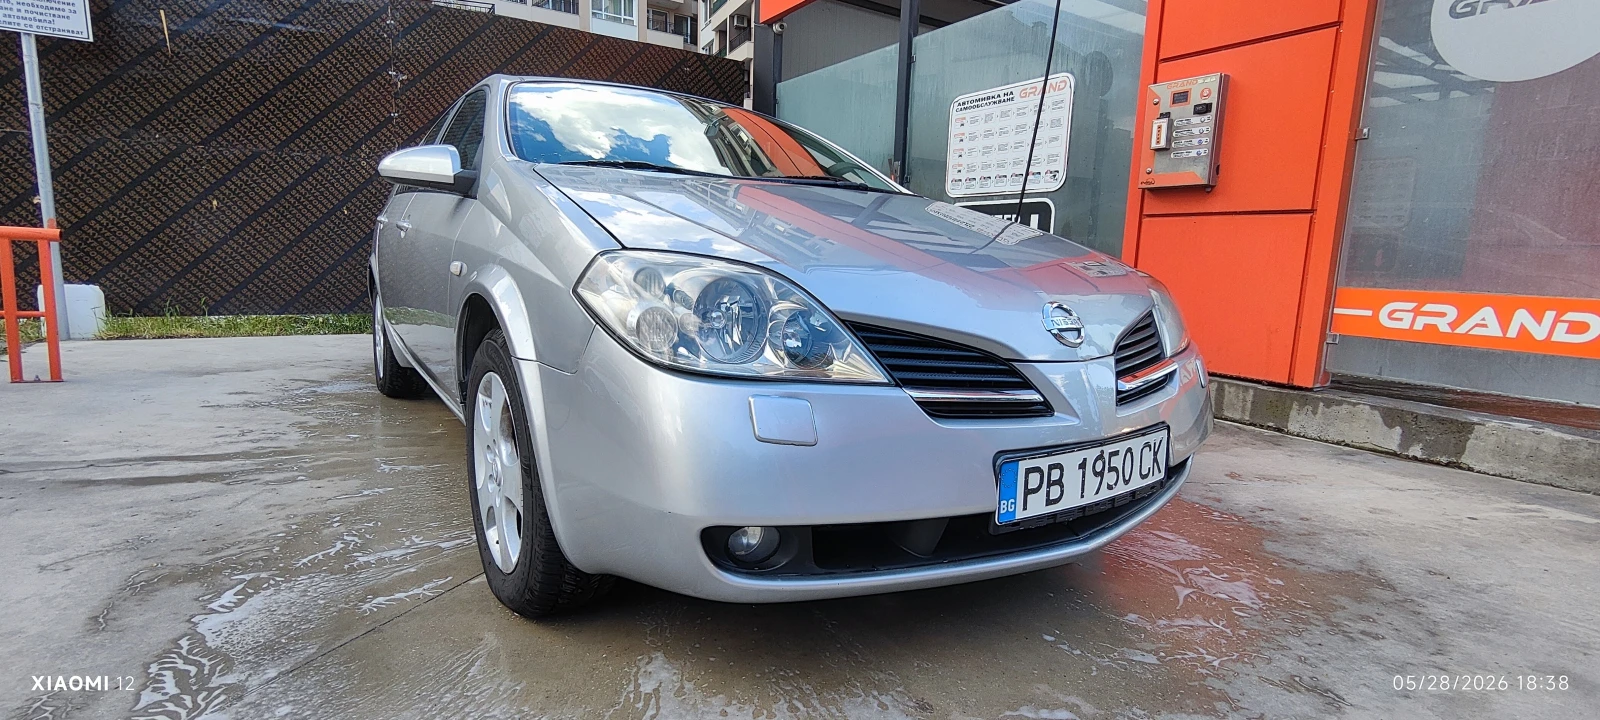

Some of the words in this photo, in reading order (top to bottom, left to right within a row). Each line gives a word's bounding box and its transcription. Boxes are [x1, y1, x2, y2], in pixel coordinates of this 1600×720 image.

[3, 13, 55, 24] автомобила!
[16, 1, 66, 12] необходимо
[24, 10, 70, 20] почистване
[314, 3, 347, 36] SKYFORM
[36, 25, 84, 35] отстраняват
[205, 16, 242, 50] SKYFORM
[291, 19, 325, 52] SKYFORM
[303, 11, 336, 44] SKYFORM
[426, 18, 454, 50] SKYFORM
[180, 34, 218, 67] SKYFORM
[256, 44, 291, 77] SKYFORM
[268, 36, 303, 69] SKYFORM
[337, 45, 369, 78] SKYFORM
[353, 33, 385, 66] SKYFORM
[410, 29, 439, 62] SKYFORM
[141, 60, 180, 94] SKYFORM
[147, 56, 186, 89] SKYFORM
[154, 52, 193, 85] SKYFORM
[160, 47, 199, 80] SKYFORM
[232, 61, 268, 94] SKYFORM
[244, 53, 280, 86] SKYFORM
[326, 54, 358, 86] SKYFORM
[134, 65, 174, 98] SKYFORM
[214, 74, 250, 107] SKYFORM
[298, 74, 332, 107] SKYFORM
[309, 66, 342, 99] SKYFORM
[189, 92, 226, 126] SKYFORM
[201, 83, 238, 116] SKYFORM
[275, 91, 310, 124] SKYFORM
[287, 83, 321, 116] SKYFORM
[343, 98, 375, 131] SKYFORM
[354, 90, 385, 123] SKYFORM
[410, 85, 439, 117] SKYFORM
[956, 96, 1015, 112] САМООБСЛУЖВАНЕ
[957, 94, 1001, 107] АВТОМИВКА
[163, 110, 202, 144] SKYFORM
[170, 105, 208, 139] SKYFORM
[176, 101, 214, 134] SKYFORM
[240, 117, 276, 150] SKYFORM
[258, 104, 293, 137] SKYFORM
[321, 115, 354, 148] SKYFORM
[332, 107, 364, 140] SKYFORM
[310, 124, 343, 156] SKYFORM
[160, 165, 199, 198] SKYFORM
[172, 156, 211, 189] SKYFORM
[248, 161, 283, 194] SKYFORM
[260, 152, 295, 185] SKYFORM
[323, 161, 355, 194] SKYFORM
[134, 184, 174, 218] SKYFORM
[141, 179, 180, 213] SKYFORM
[147, 174, 186, 208] SKYFORM
[154, 170, 193, 203] SKYFORM
[224, 178, 260, 212] SKYFORM
[236, 170, 272, 203] SKYFORM
[295, 183, 328, 216] SKYFORM
[212, 188, 249, 221] SKYFORM
[273, 200, 307, 233] SKYFORM
[284, 191, 318, 224] SKYFORM
[163, 225, 202, 259] SKYFORM
[175, 216, 214, 249] SKYFORM
[182, 211, 220, 244] SKYFORM
[250, 219, 285, 252] SKYFORM
[261, 209, 296, 242] SKYFORM
[312, 225, 345, 258] SKYFORM
[329, 212, 361, 245] SKYFORM
[144, 240, 184, 274] SKYFORM
[150, 235, 190, 268] SKYFORM
[156, 230, 196, 264] SKYFORM
[220, 242, 257, 275] SKYFORM
[226, 237, 263, 270] SKYFORM
[238, 228, 274, 261] SKYFORM
[296, 238, 330, 271] SKYFORM
[131, 250, 171, 283] SKYFORM
[196, 260, 234, 294] SKYFORM
[208, 251, 245, 284] SKYFORM
[263, 266, 298, 299] SKYFORM
[280, 252, 314, 285] SKYFORM
[330, 266, 362, 299] SKYFORM
[1378, 302, 1600, 343] GRAND
[1022, 462, 1064, 511] PB
[1078, 446, 1134, 499] 1950
[1139, 436, 1164, 480] CK
[1000, 498, 1015, 514] BG
